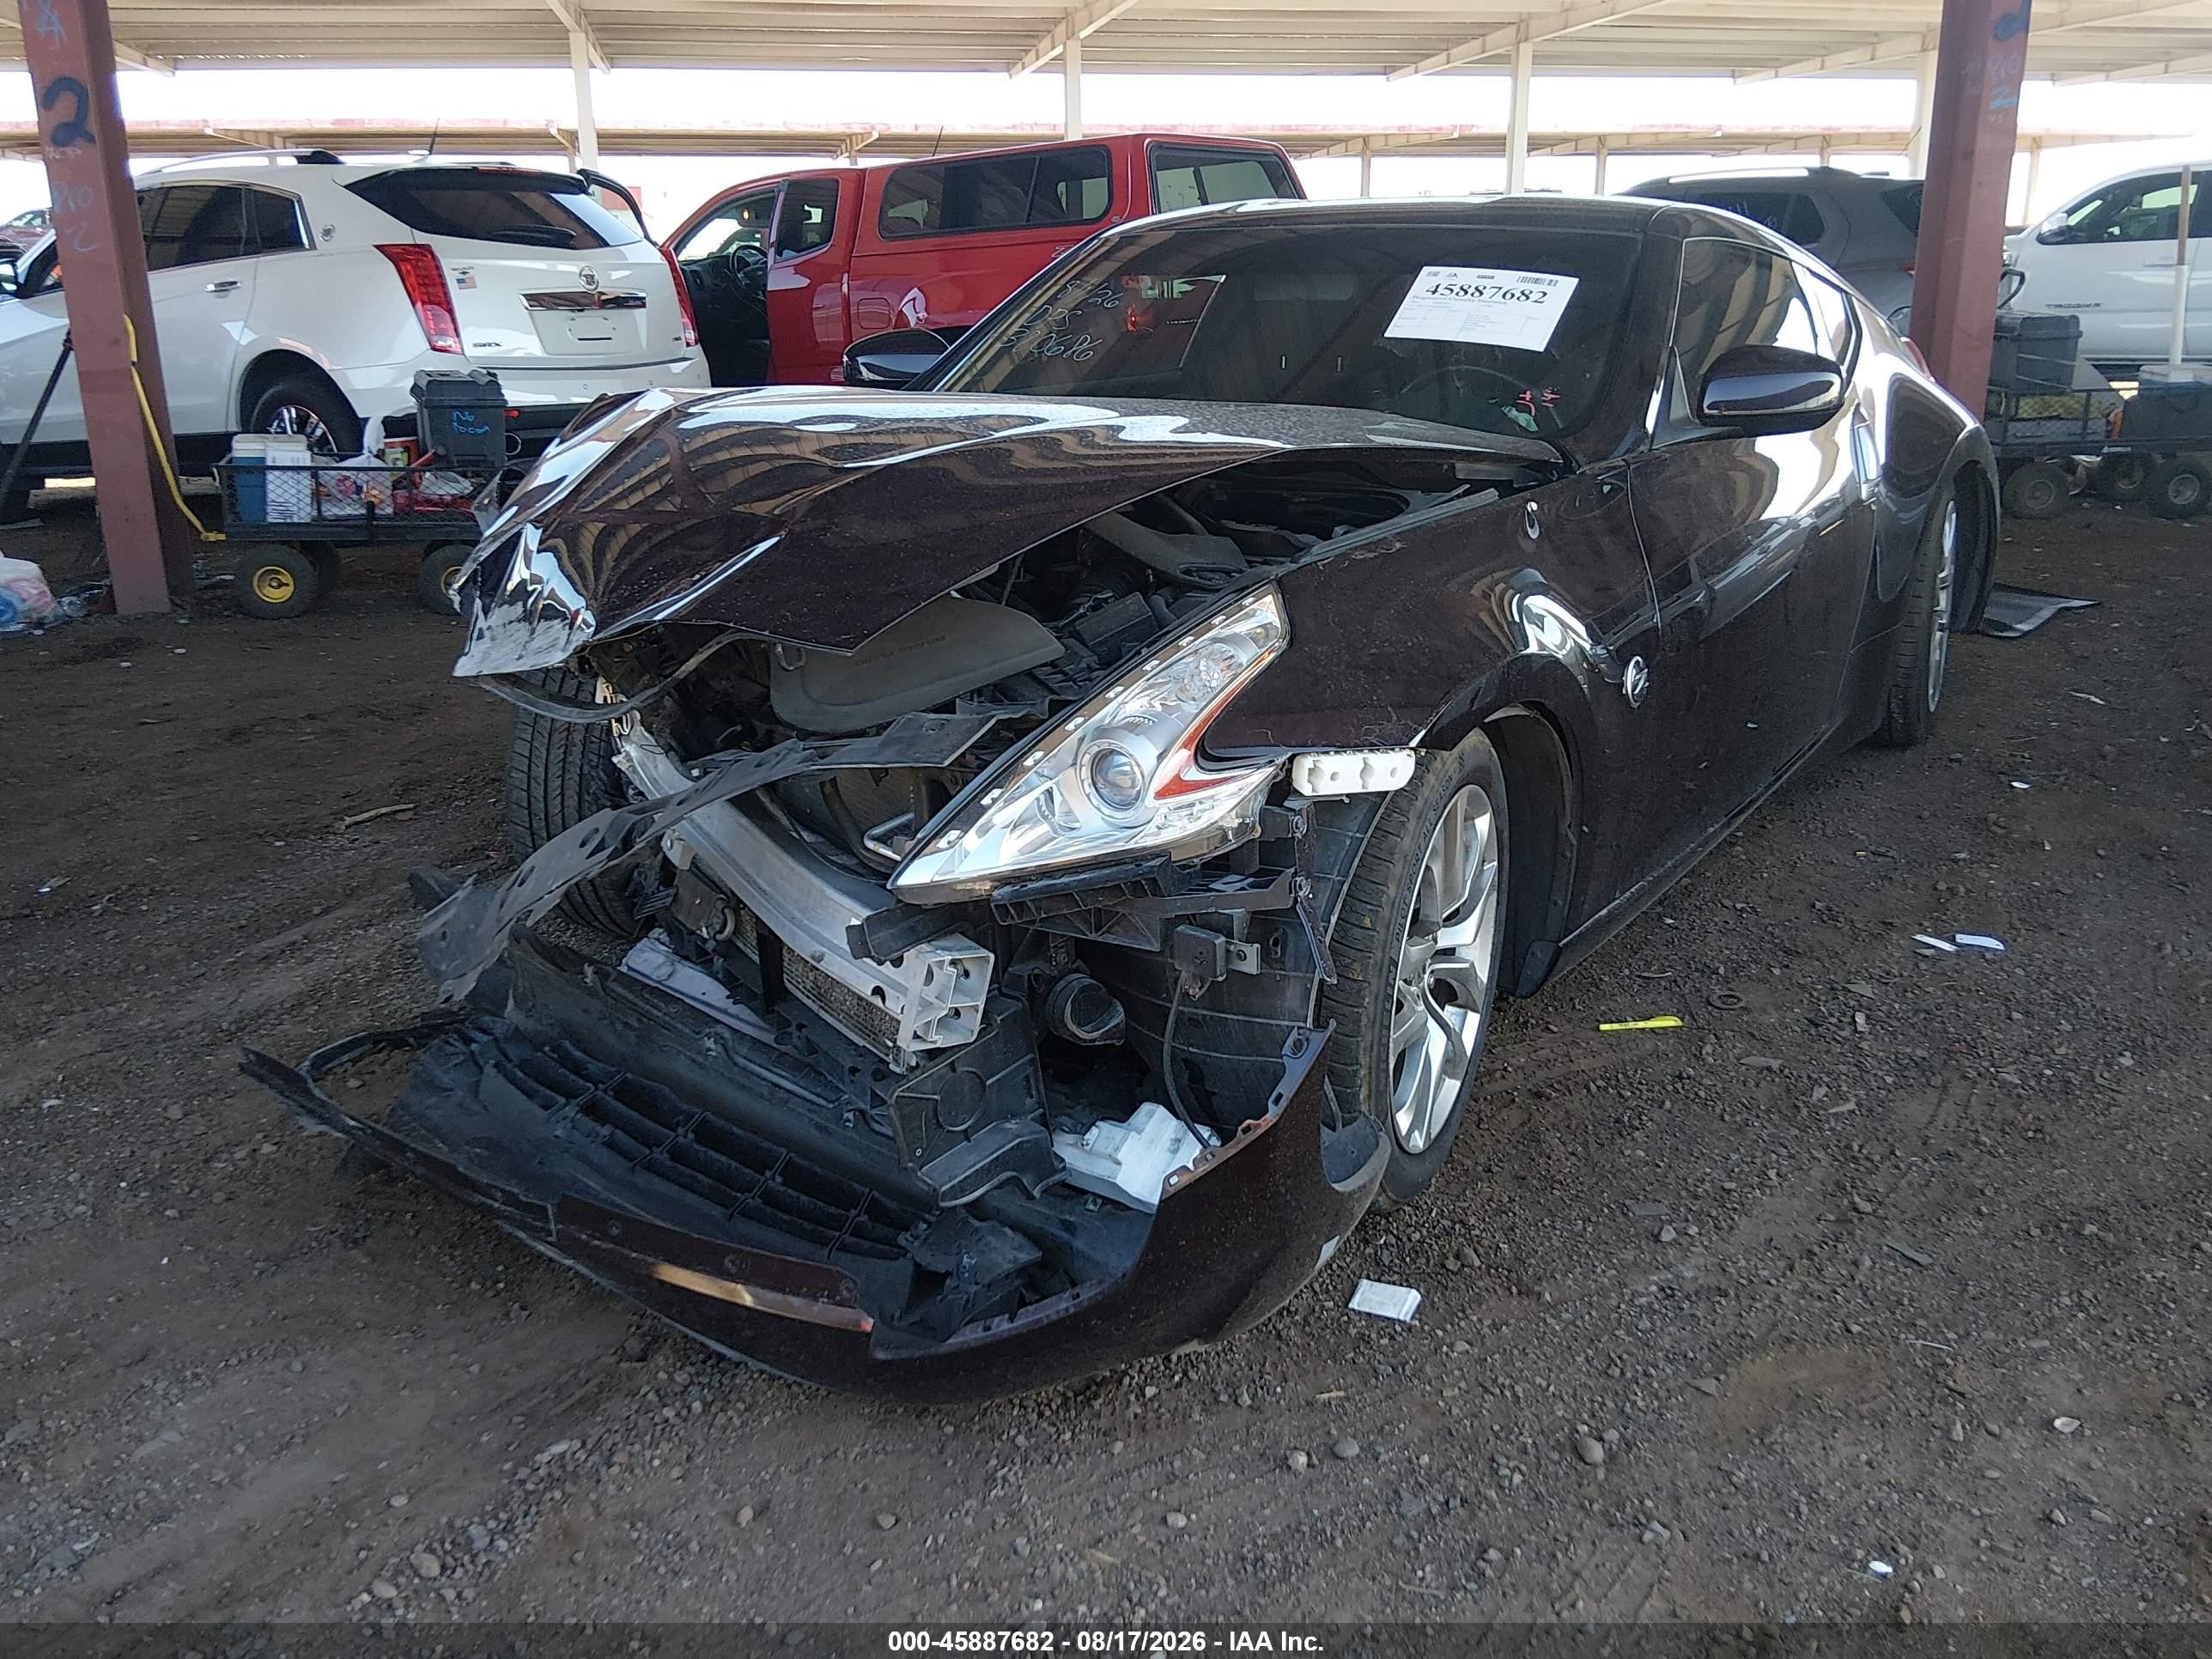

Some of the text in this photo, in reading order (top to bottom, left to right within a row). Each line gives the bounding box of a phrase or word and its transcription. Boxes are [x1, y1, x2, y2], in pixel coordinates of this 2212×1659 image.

[41, 76, 96, 148] 2
[1425, 283, 1547, 304] 45887682
[452, 410, 475, 422] No
[1395, 899, 1409, 943] PILOT
[1407, 842, 1423, 894] SPORT
